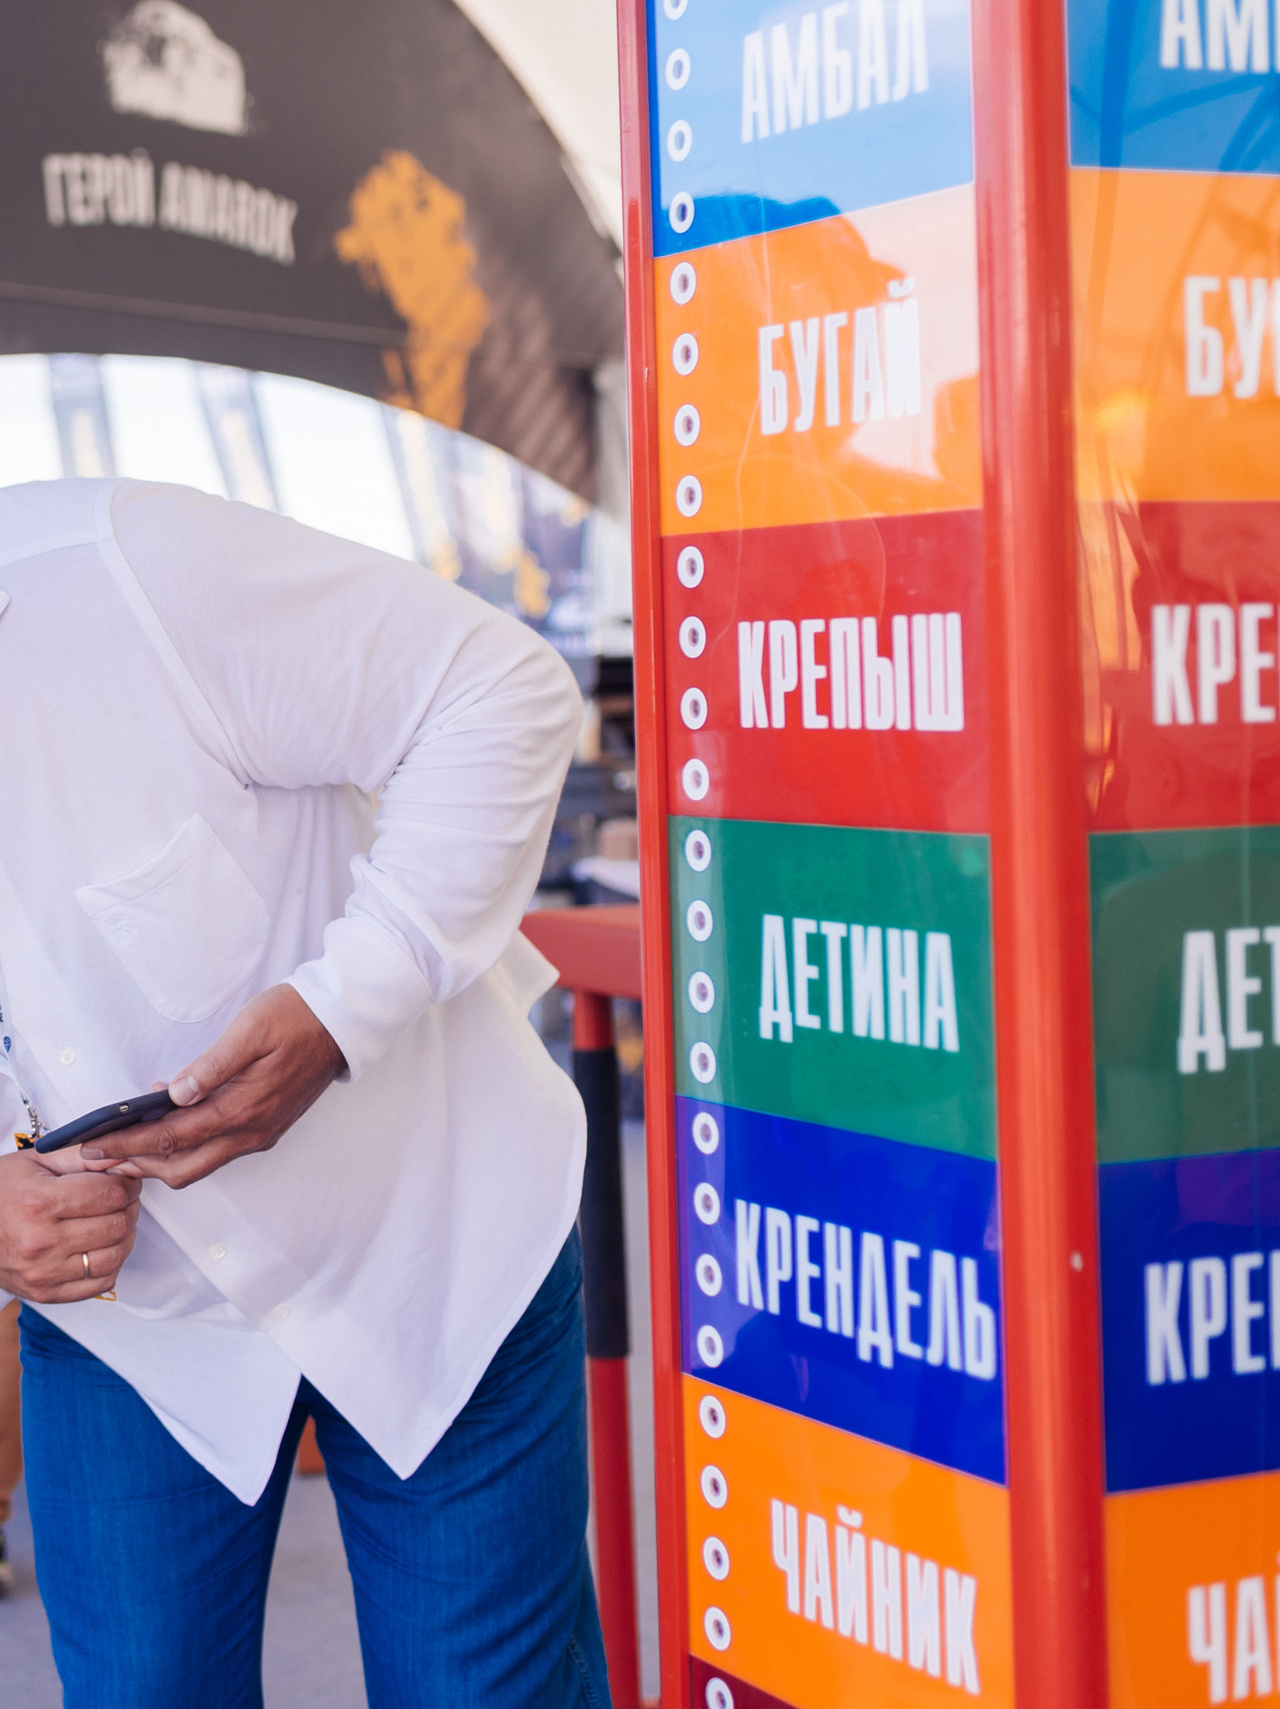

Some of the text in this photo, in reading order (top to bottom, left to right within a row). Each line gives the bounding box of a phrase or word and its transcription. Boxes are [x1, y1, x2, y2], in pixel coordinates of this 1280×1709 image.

[741, 0, 929, 143] АМБАЛ
[1159, 0, 1280, 74] АМ
[42, 147, 299, 267] ГЕРОЙ AMAROK
[758, 276, 921, 435] БУГАЙ
[1184, 275, 1280, 398] БУ
[737, 611, 965, 732] КРЕПЫШ
[758, 913, 960, 1054] ДЕТИНА
[734, 1199, 998, 1381] КРЕНДЕЛЬ
[1144, 1249, 1280, 1386] КРЕ
[770, 1496, 982, 1695] ЧАЙНИК
[1186, 1554, 1280, 1707] ЧА
